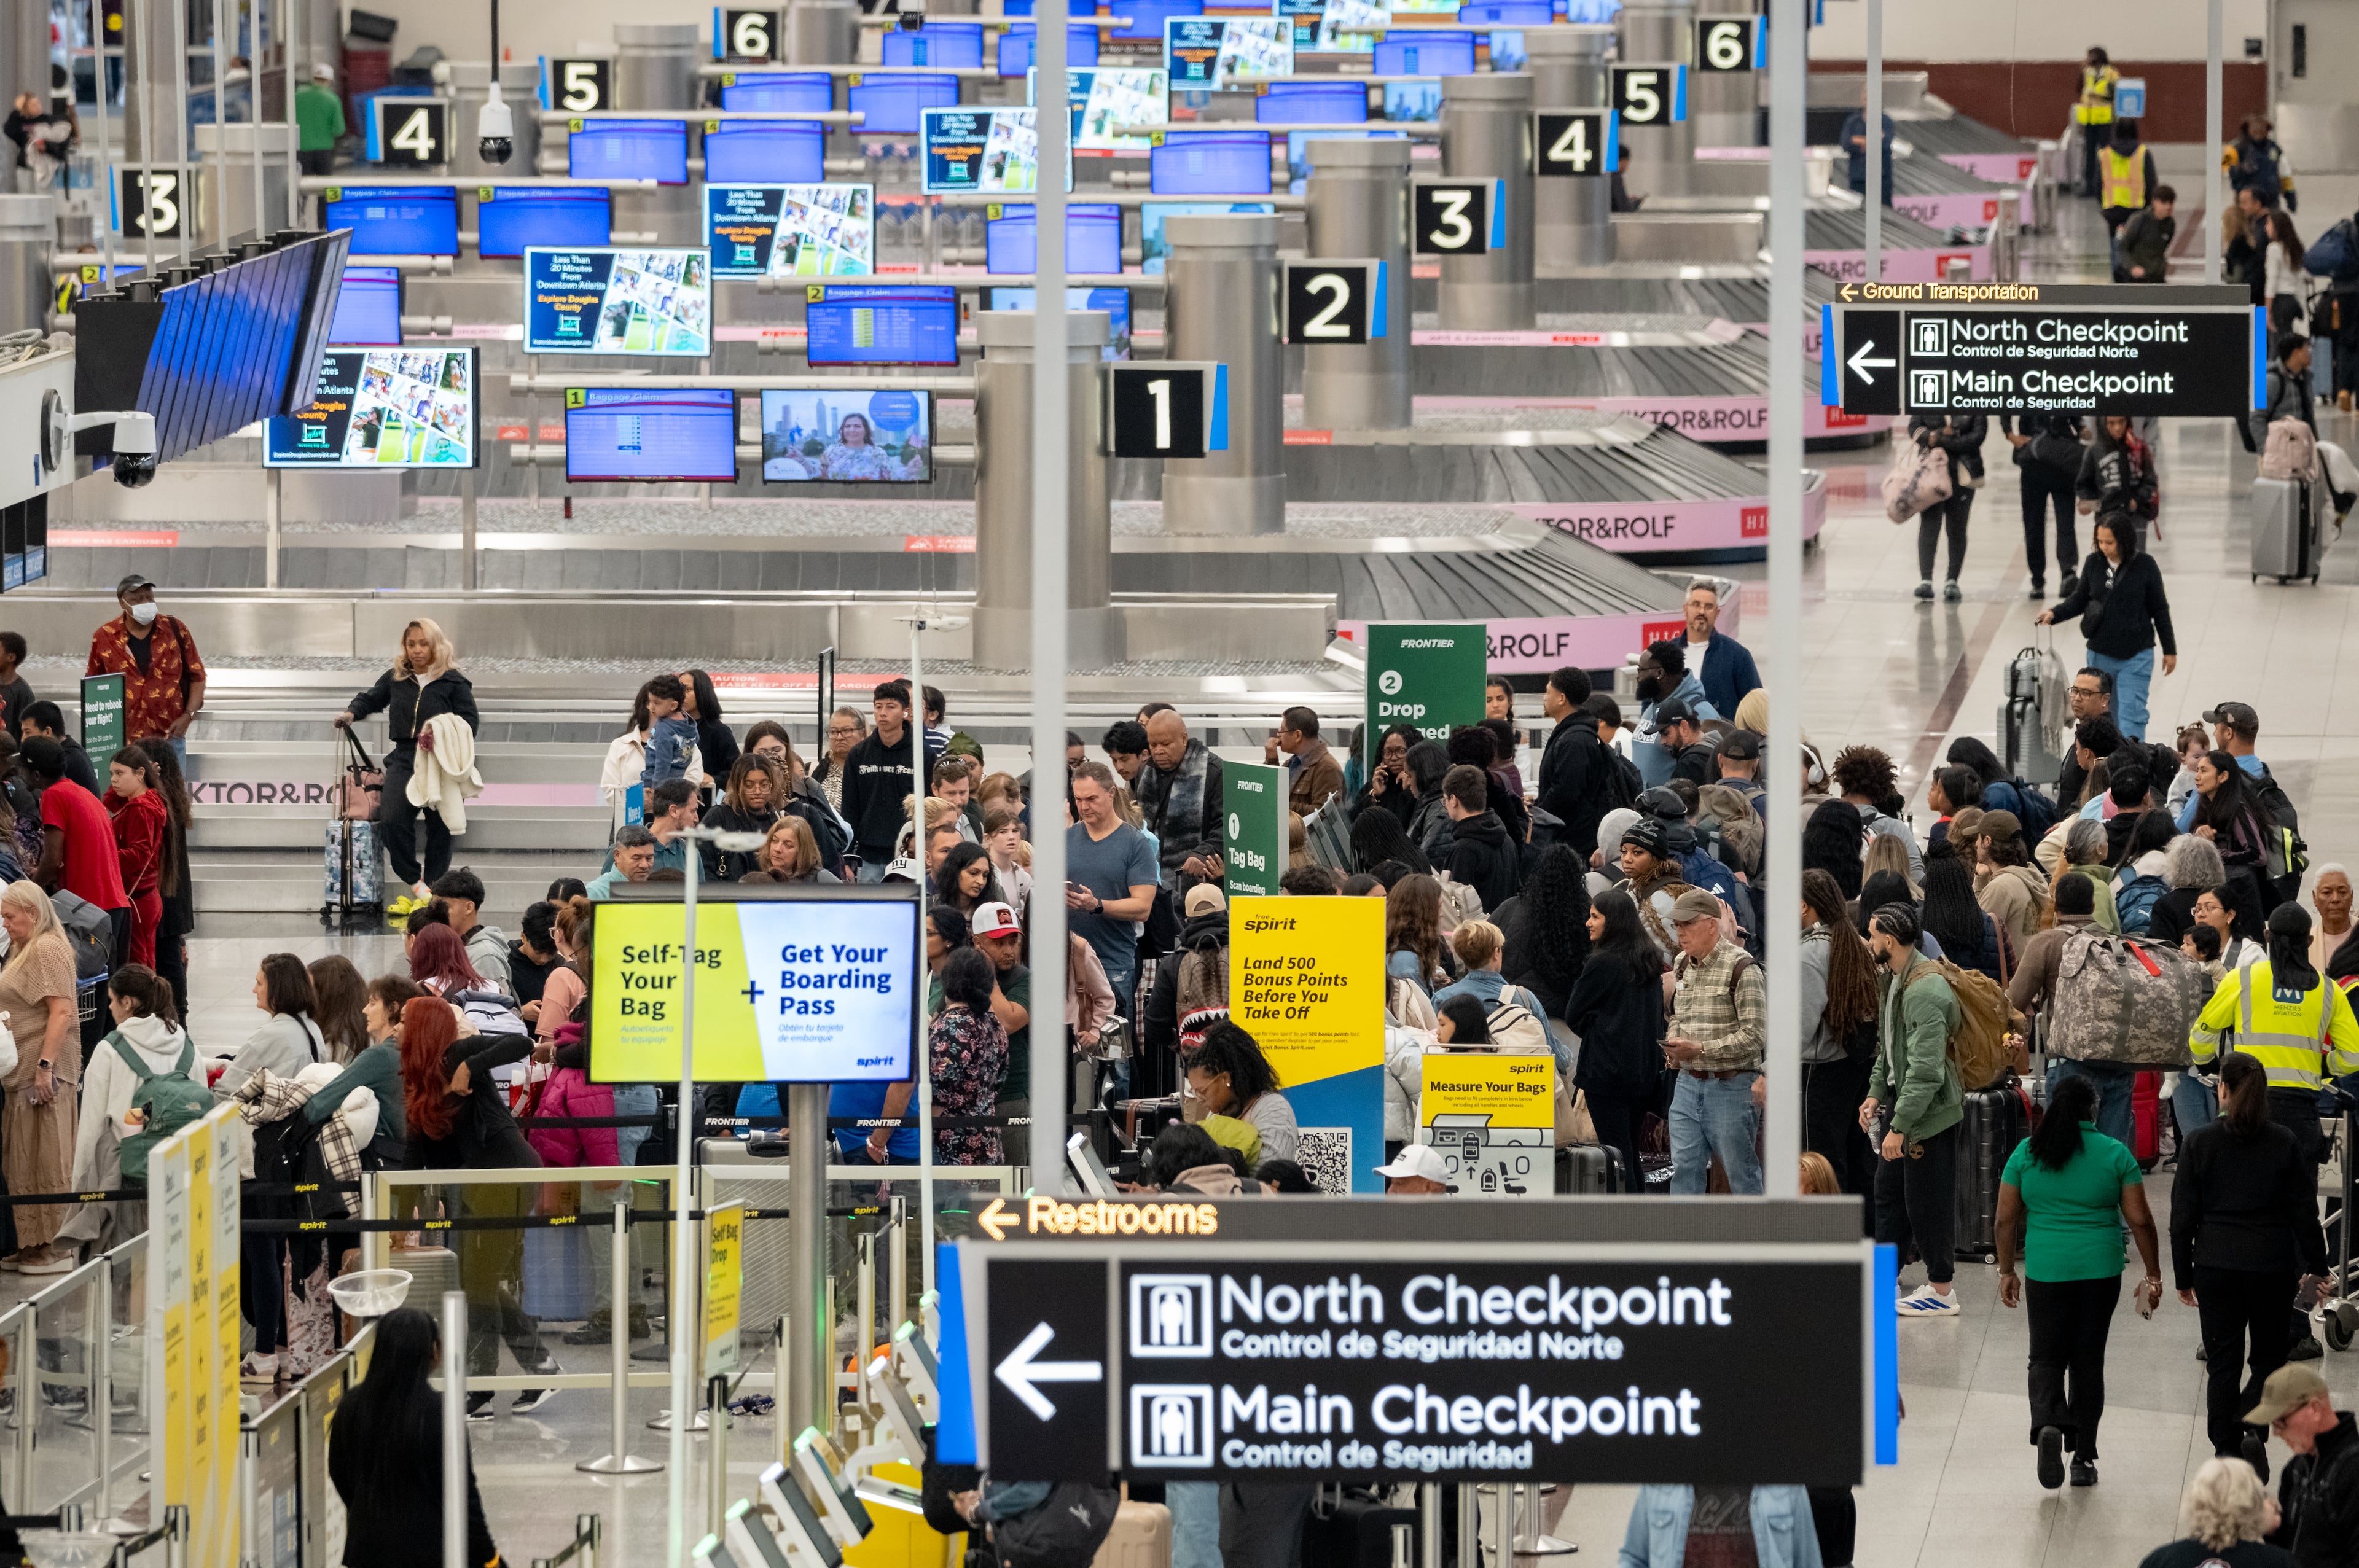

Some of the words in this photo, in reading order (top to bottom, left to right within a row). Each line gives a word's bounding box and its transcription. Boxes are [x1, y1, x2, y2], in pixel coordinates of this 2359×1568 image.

[733, 12, 769, 57] 6
[1707, 22, 1743, 69] 6
[562, 63, 599, 112] 5
[1622, 71, 1660, 122] 5
[391, 108, 436, 160] 4
[1547, 119, 1592, 172] 4
[328, 188, 340, 201] 3
[482, 188, 491, 202] 3
[136, 175, 179, 233] 3
[990, 205, 1000, 219] 3
[1430, 190, 1472, 249] 3
[571, 255, 590, 264] Than
[86, 268, 97, 281] 2
[563, 264, 593, 273] Minutes
[536, 280, 577, 290] Downtown
[578, 281, 606, 290] Atlanta
[1863, 283, 1923, 300] Ground
[1928, 281, 2038, 303] Transportation
[811, 287, 821, 300] 2
[1303, 273, 1351, 337] 2
[1952, 318, 2028, 341] North
[2036, 318, 2188, 348] Checkpoint
[1952, 344, 2002, 358] Control
[2005, 344, 2024, 358] de
[2027, 344, 2096, 361] Seguridad
[2105, 345, 2138, 359] Norte
[324, 385, 354, 395] Atlanta
[1952, 370, 2013, 393] Main
[2022, 370, 2174, 397] Checkpoint
[571, 391, 582, 404] 1
[589, 393, 631, 403] Baggage
[1952, 396, 2002, 409] Control
[2005, 396, 2024, 409] de
[2027, 396, 2095, 411] Seguridad
[312, 401, 346, 412] Douglas
[1147, 379, 1170, 449] 1
[1400, 639, 1455, 649] FRONTIER
[1385, 676, 1396, 690] 2
[85, 701, 99, 712] Need
[99, 700, 104, 711] to
[104, 699, 122, 710] rebook
[1379, 701, 1426, 719] Drop
[85, 716, 97, 728] your
[97, 712, 113, 725] flight?
[859, 765, 878, 775] Faith
[1238, 781, 1263, 792] FRONTIER
[1232, 819, 1237, 834] 1
[892, 859, 907, 870] ny
[1229, 847, 1246, 868] Tag
[1247, 849, 1265, 872] Bag
[1230, 880, 1241, 891] Scan
[1242, 882, 1266, 895] boarding
[1244, 918, 1297, 933] spirit
[781, 944, 824, 964] Get
[831, 944, 888, 963] Your
[1243, 956, 1284, 969] Land
[1287, 957, 1316, 969] 500
[620, 971, 676, 990] Your
[781, 969, 891, 994] Boarding
[1243, 973, 1293, 986] Bonus
[1297, 972, 1348, 986] Points
[1243, 989, 1296, 1003] Before
[1302, 989, 1328, 1003] You
[620, 998, 666, 1021] Bag
[780, 997, 835, 1016] Pass
[1244, 1006, 1280, 1020] Take
[1285, 1005, 1311, 1020] Off
[620, 1024, 674, 1034] Autoetiqueta
[816, 1023, 844, 1034] tarjeta
[632, 1034, 668, 1045] equipaje
[789, 1034, 834, 1045] embarque
[856, 1056, 894, 1068] spirit
[1509, 1064, 1545, 1075] spirit
[1430, 1081, 1482, 1092] Measure
[1485, 1082, 1514, 1092] Your
[1517, 1082, 1546, 1095] Bags
[705, 1117, 749, 1126] FRONTIER
[856, 1118, 902, 1127] FRONTIER
[295, 1182, 319, 1193] spirit
[80, 1191, 106, 1202] spirit
[855, 1206, 879, 1215] spirit
[1028, 1196, 1218, 1235] Restrooms
[300, 1220, 327, 1231] spirit
[425, 1219, 452, 1230] spirit
[550, 1214, 576, 1225] spirit
[713, 1226, 726, 1244] Self
[726, 1224, 738, 1242] Bag
[711, 1249, 727, 1264] Drop
[1221, 1273, 1384, 1325] North
[1400, 1273, 1732, 1333] Checkpoint
[1221, 1330, 1331, 1359] Control
[1337, 1330, 1377, 1359] de
[1382, 1329, 1532, 1363] Seguridad
[1539, 1332, 1624, 1359] Norte
[1221, 1383, 1359, 1433] Main
[1372, 1383, 1701, 1443] Checkpoint
[1221, 1440, 1332, 1468] Control
[1337, 1440, 1378, 1468] de
[1383, 1440, 1533, 1473] Seguridad
